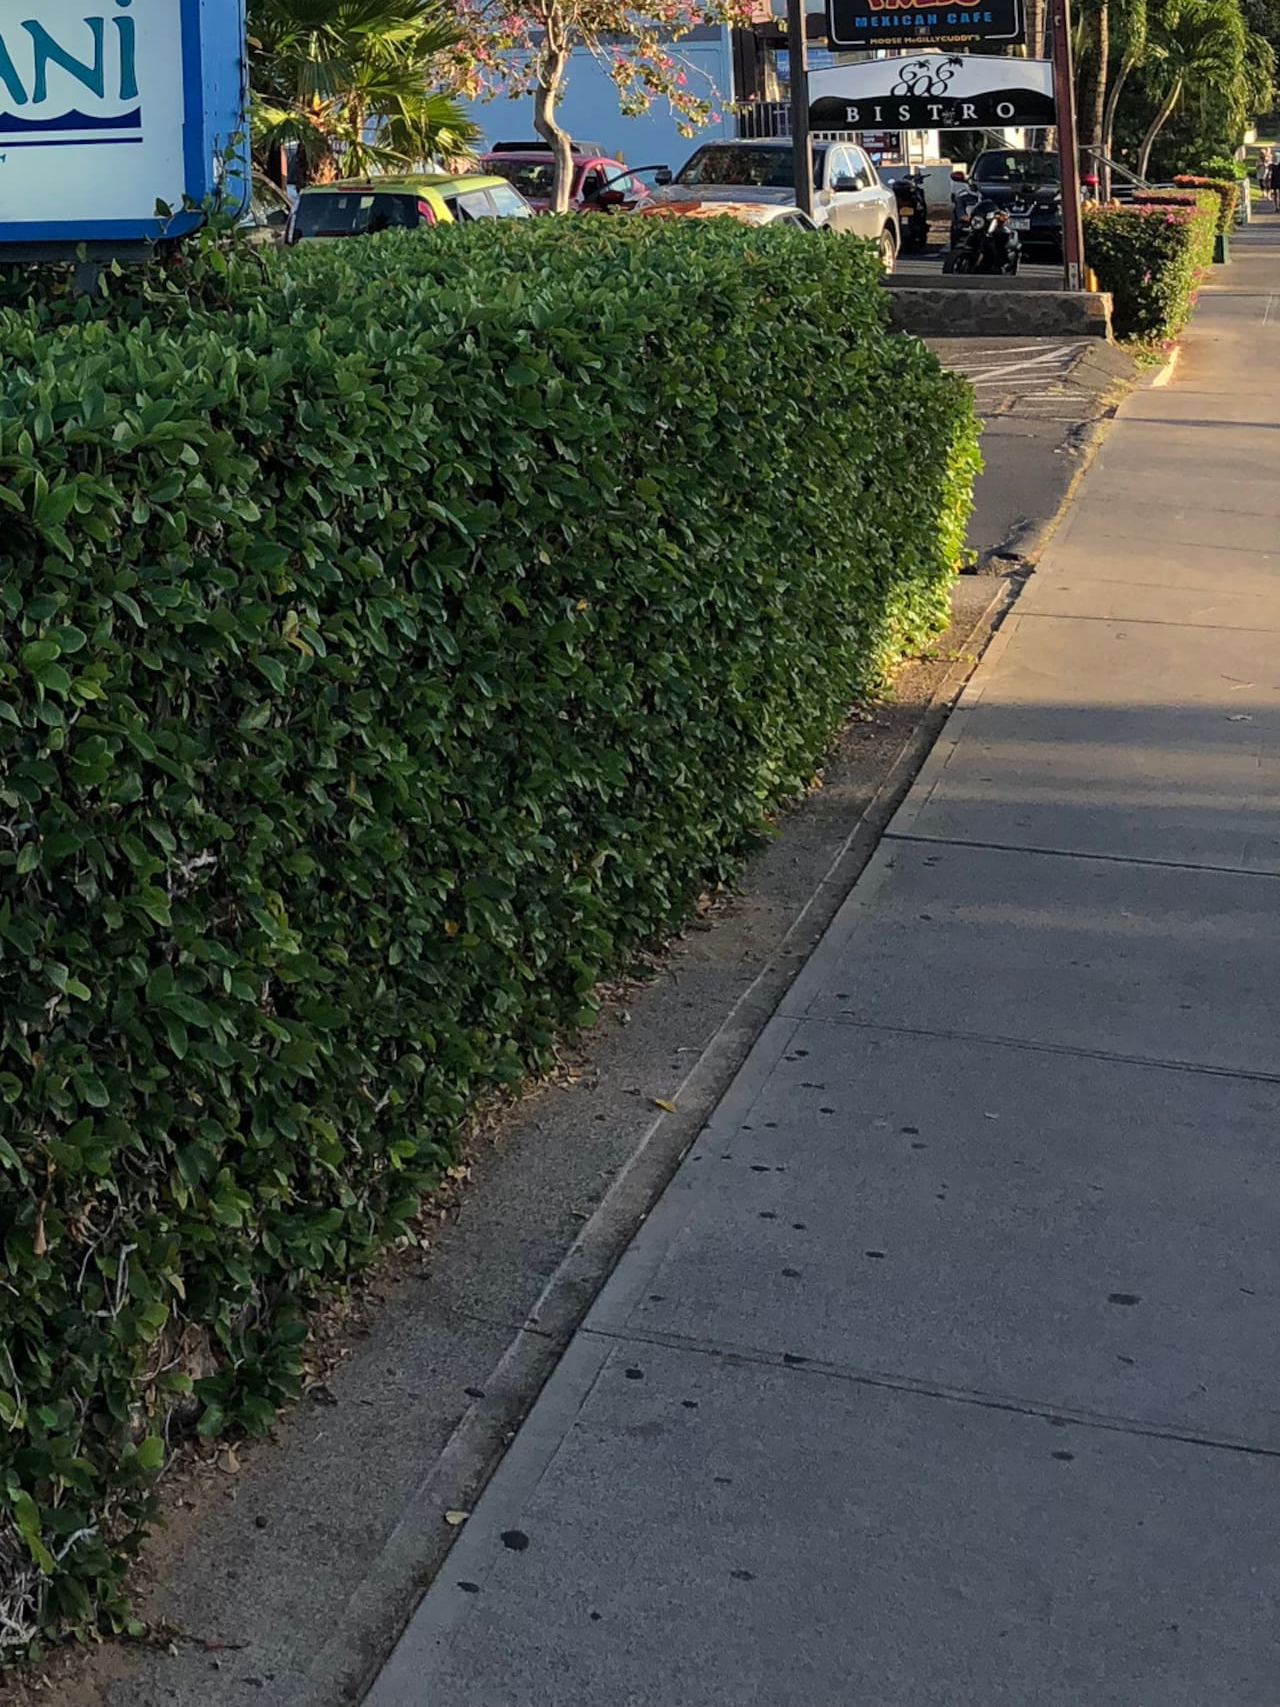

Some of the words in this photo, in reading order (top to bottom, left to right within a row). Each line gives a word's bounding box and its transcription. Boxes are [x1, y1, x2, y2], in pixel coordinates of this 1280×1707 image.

[855, 14, 937, 28] MEXICAN
[947, 12, 992, 24] CAFE
[870, 37, 902, 45] MOOSE
[846, 102, 1015, 123] BISTRO
